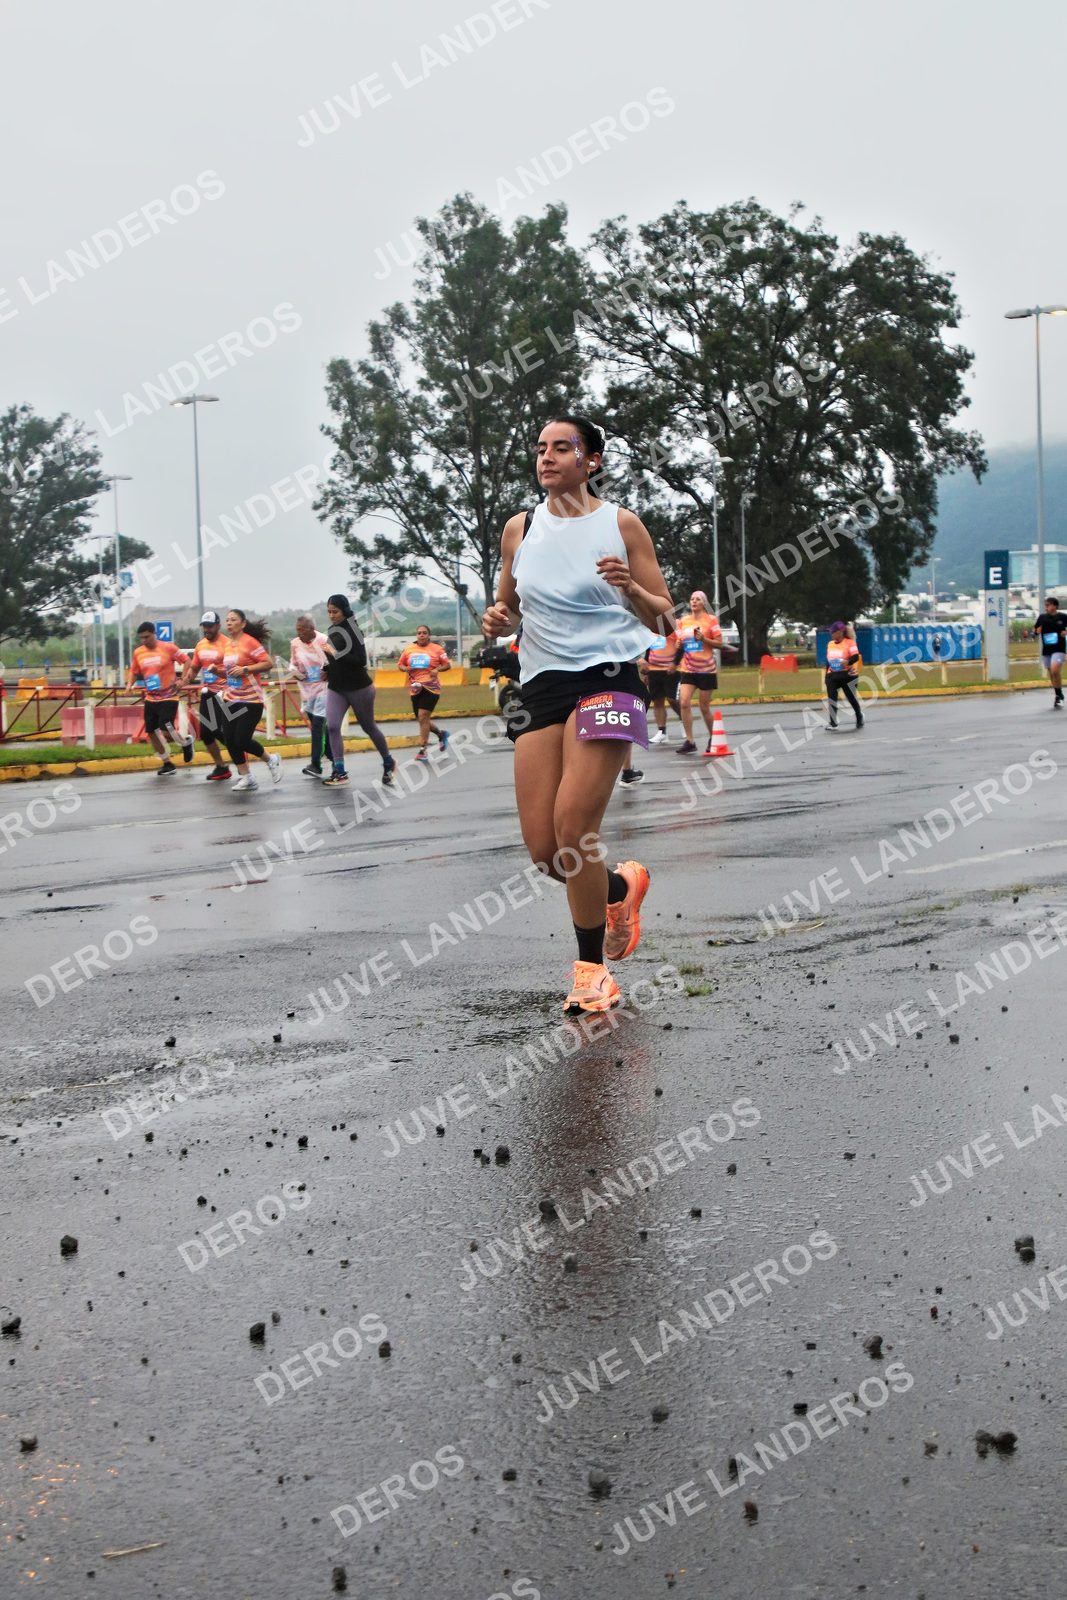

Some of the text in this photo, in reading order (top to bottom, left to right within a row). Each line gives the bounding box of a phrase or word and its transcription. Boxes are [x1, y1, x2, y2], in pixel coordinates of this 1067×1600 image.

[989, 566, 1002, 584] E
[580, 694, 613, 708] CARRERA
[595, 711, 631, 726] 566
